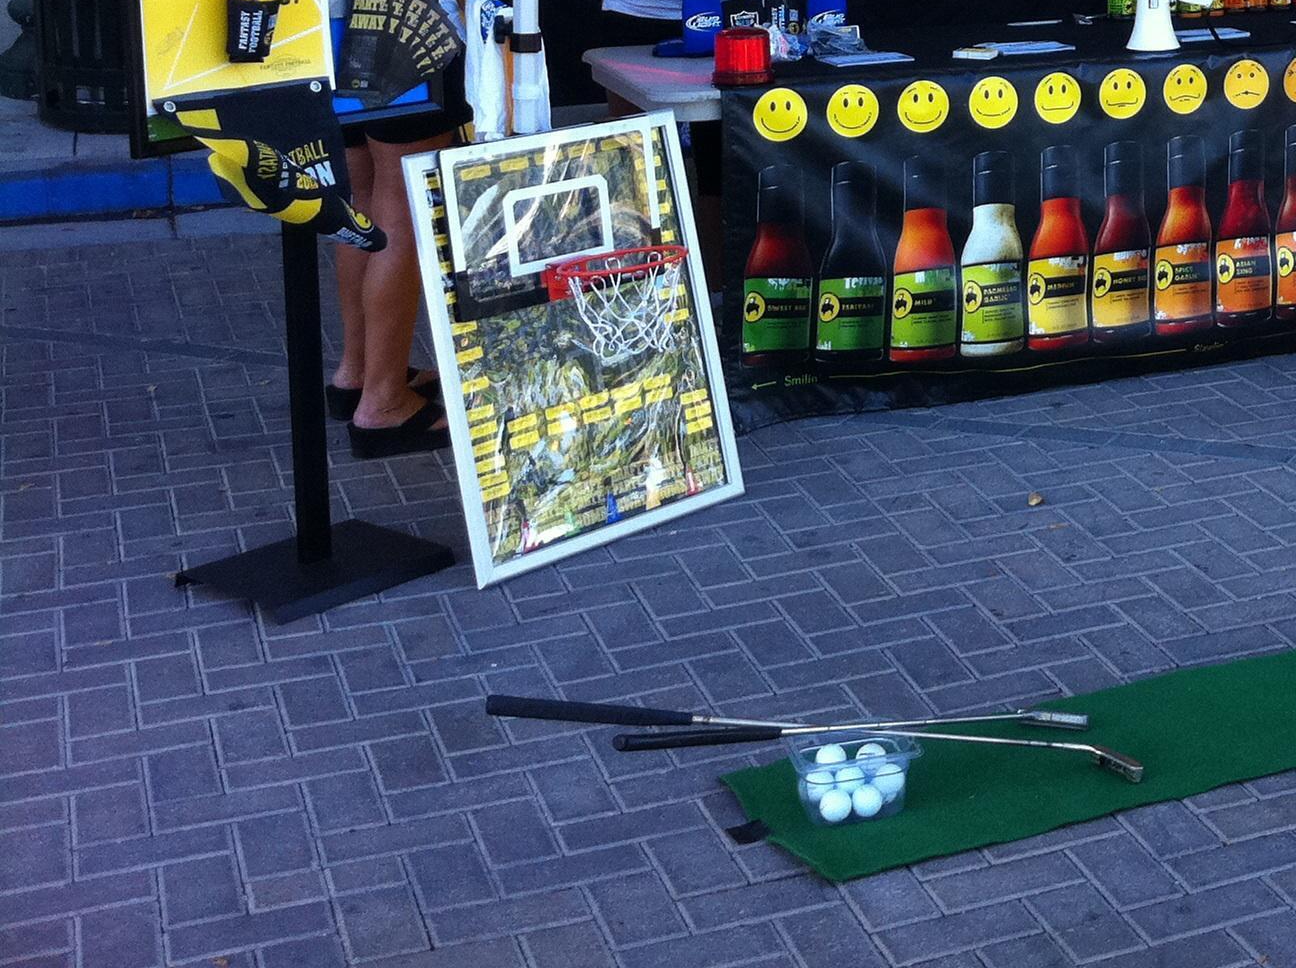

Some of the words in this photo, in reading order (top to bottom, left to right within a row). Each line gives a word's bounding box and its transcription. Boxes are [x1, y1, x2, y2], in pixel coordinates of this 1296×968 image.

[238, 10, 251, 50] FANTASY
[248, 9, 264, 53] FOOTBALL
[349, 13, 387, 30] AWAY
[288, 139, 329, 164] TBALL
